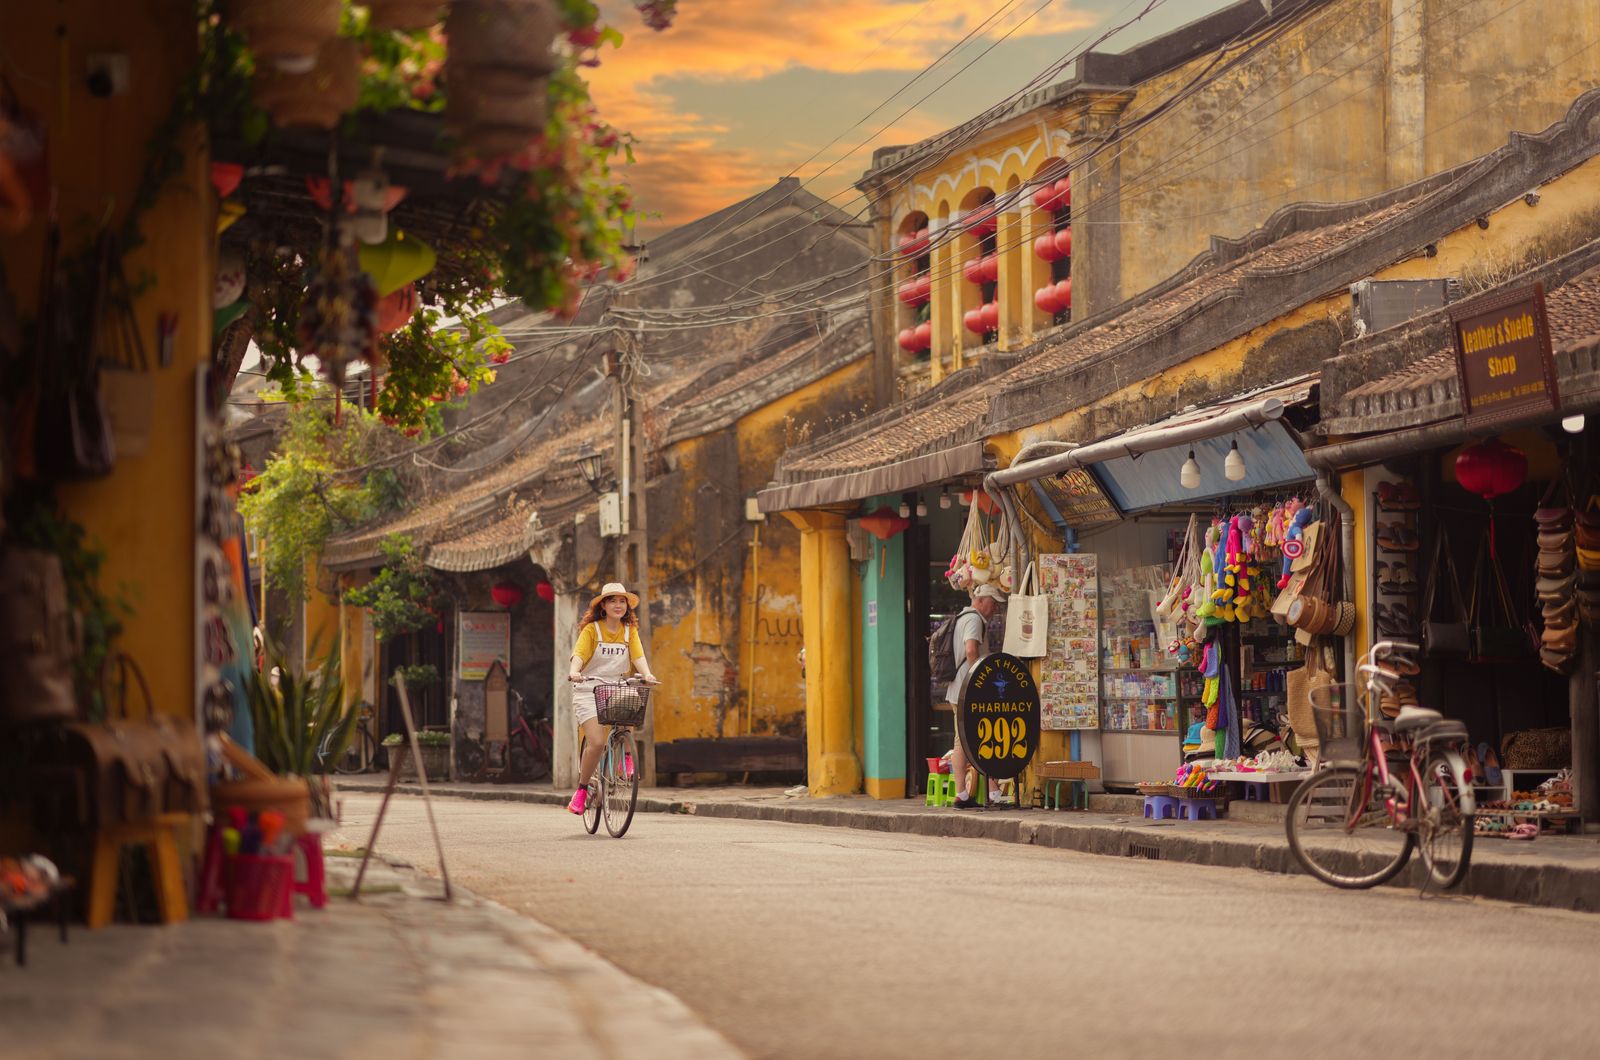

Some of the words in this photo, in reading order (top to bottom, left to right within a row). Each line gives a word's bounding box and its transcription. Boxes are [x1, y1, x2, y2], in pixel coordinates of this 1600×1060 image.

[1462, 325, 1496, 354] Leather
[1497, 323, 1505, 345] &
[1503, 312, 1535, 343] Suede
[1488, 355, 1517, 378] Shop
[971, 702, 1033, 712] PHARMACY
[977, 716, 1028, 760] 292
